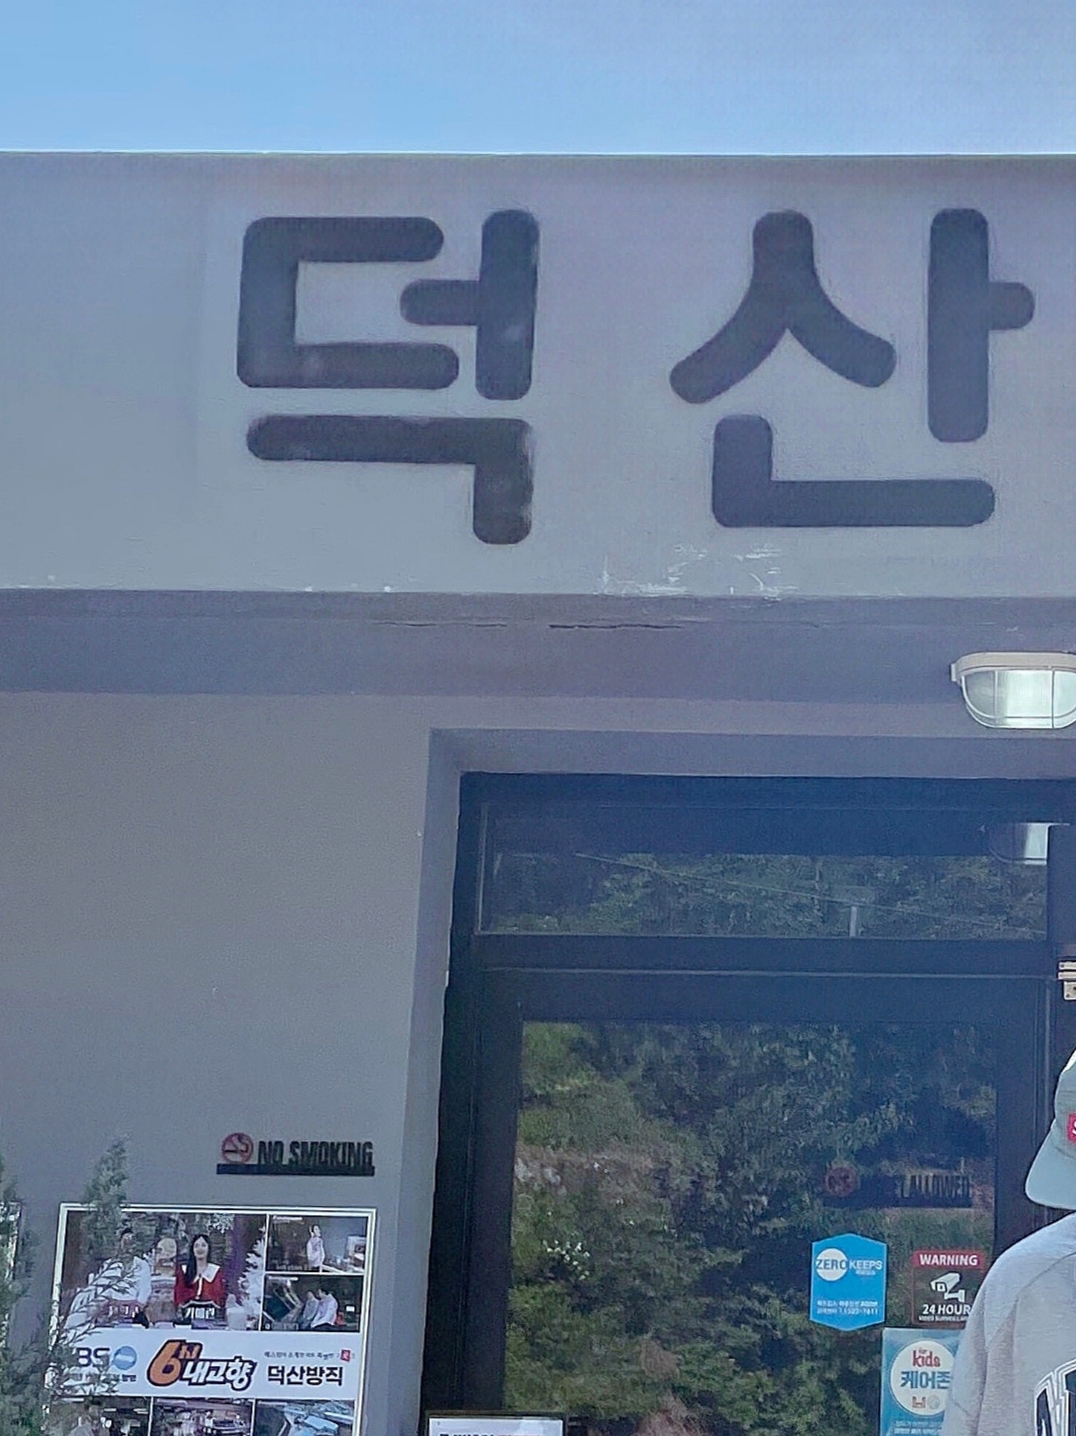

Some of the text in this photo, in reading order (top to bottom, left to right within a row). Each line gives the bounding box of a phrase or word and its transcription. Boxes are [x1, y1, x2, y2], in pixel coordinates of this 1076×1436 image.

[257, 1140, 375, 1167] NO SMOKING
[815, 1259, 883, 1270] ZERO KEEPS
[919, 1254, 978, 1266] WARNING
[922, 1303, 973, 1315] 24 HOUR
[913, 1351, 941, 1367] kids
[182, 1356, 256, 1391] 내고향
[268, 1366, 343, 1386] 덕산방직
[900, 1371, 951, 1389] 케어존
